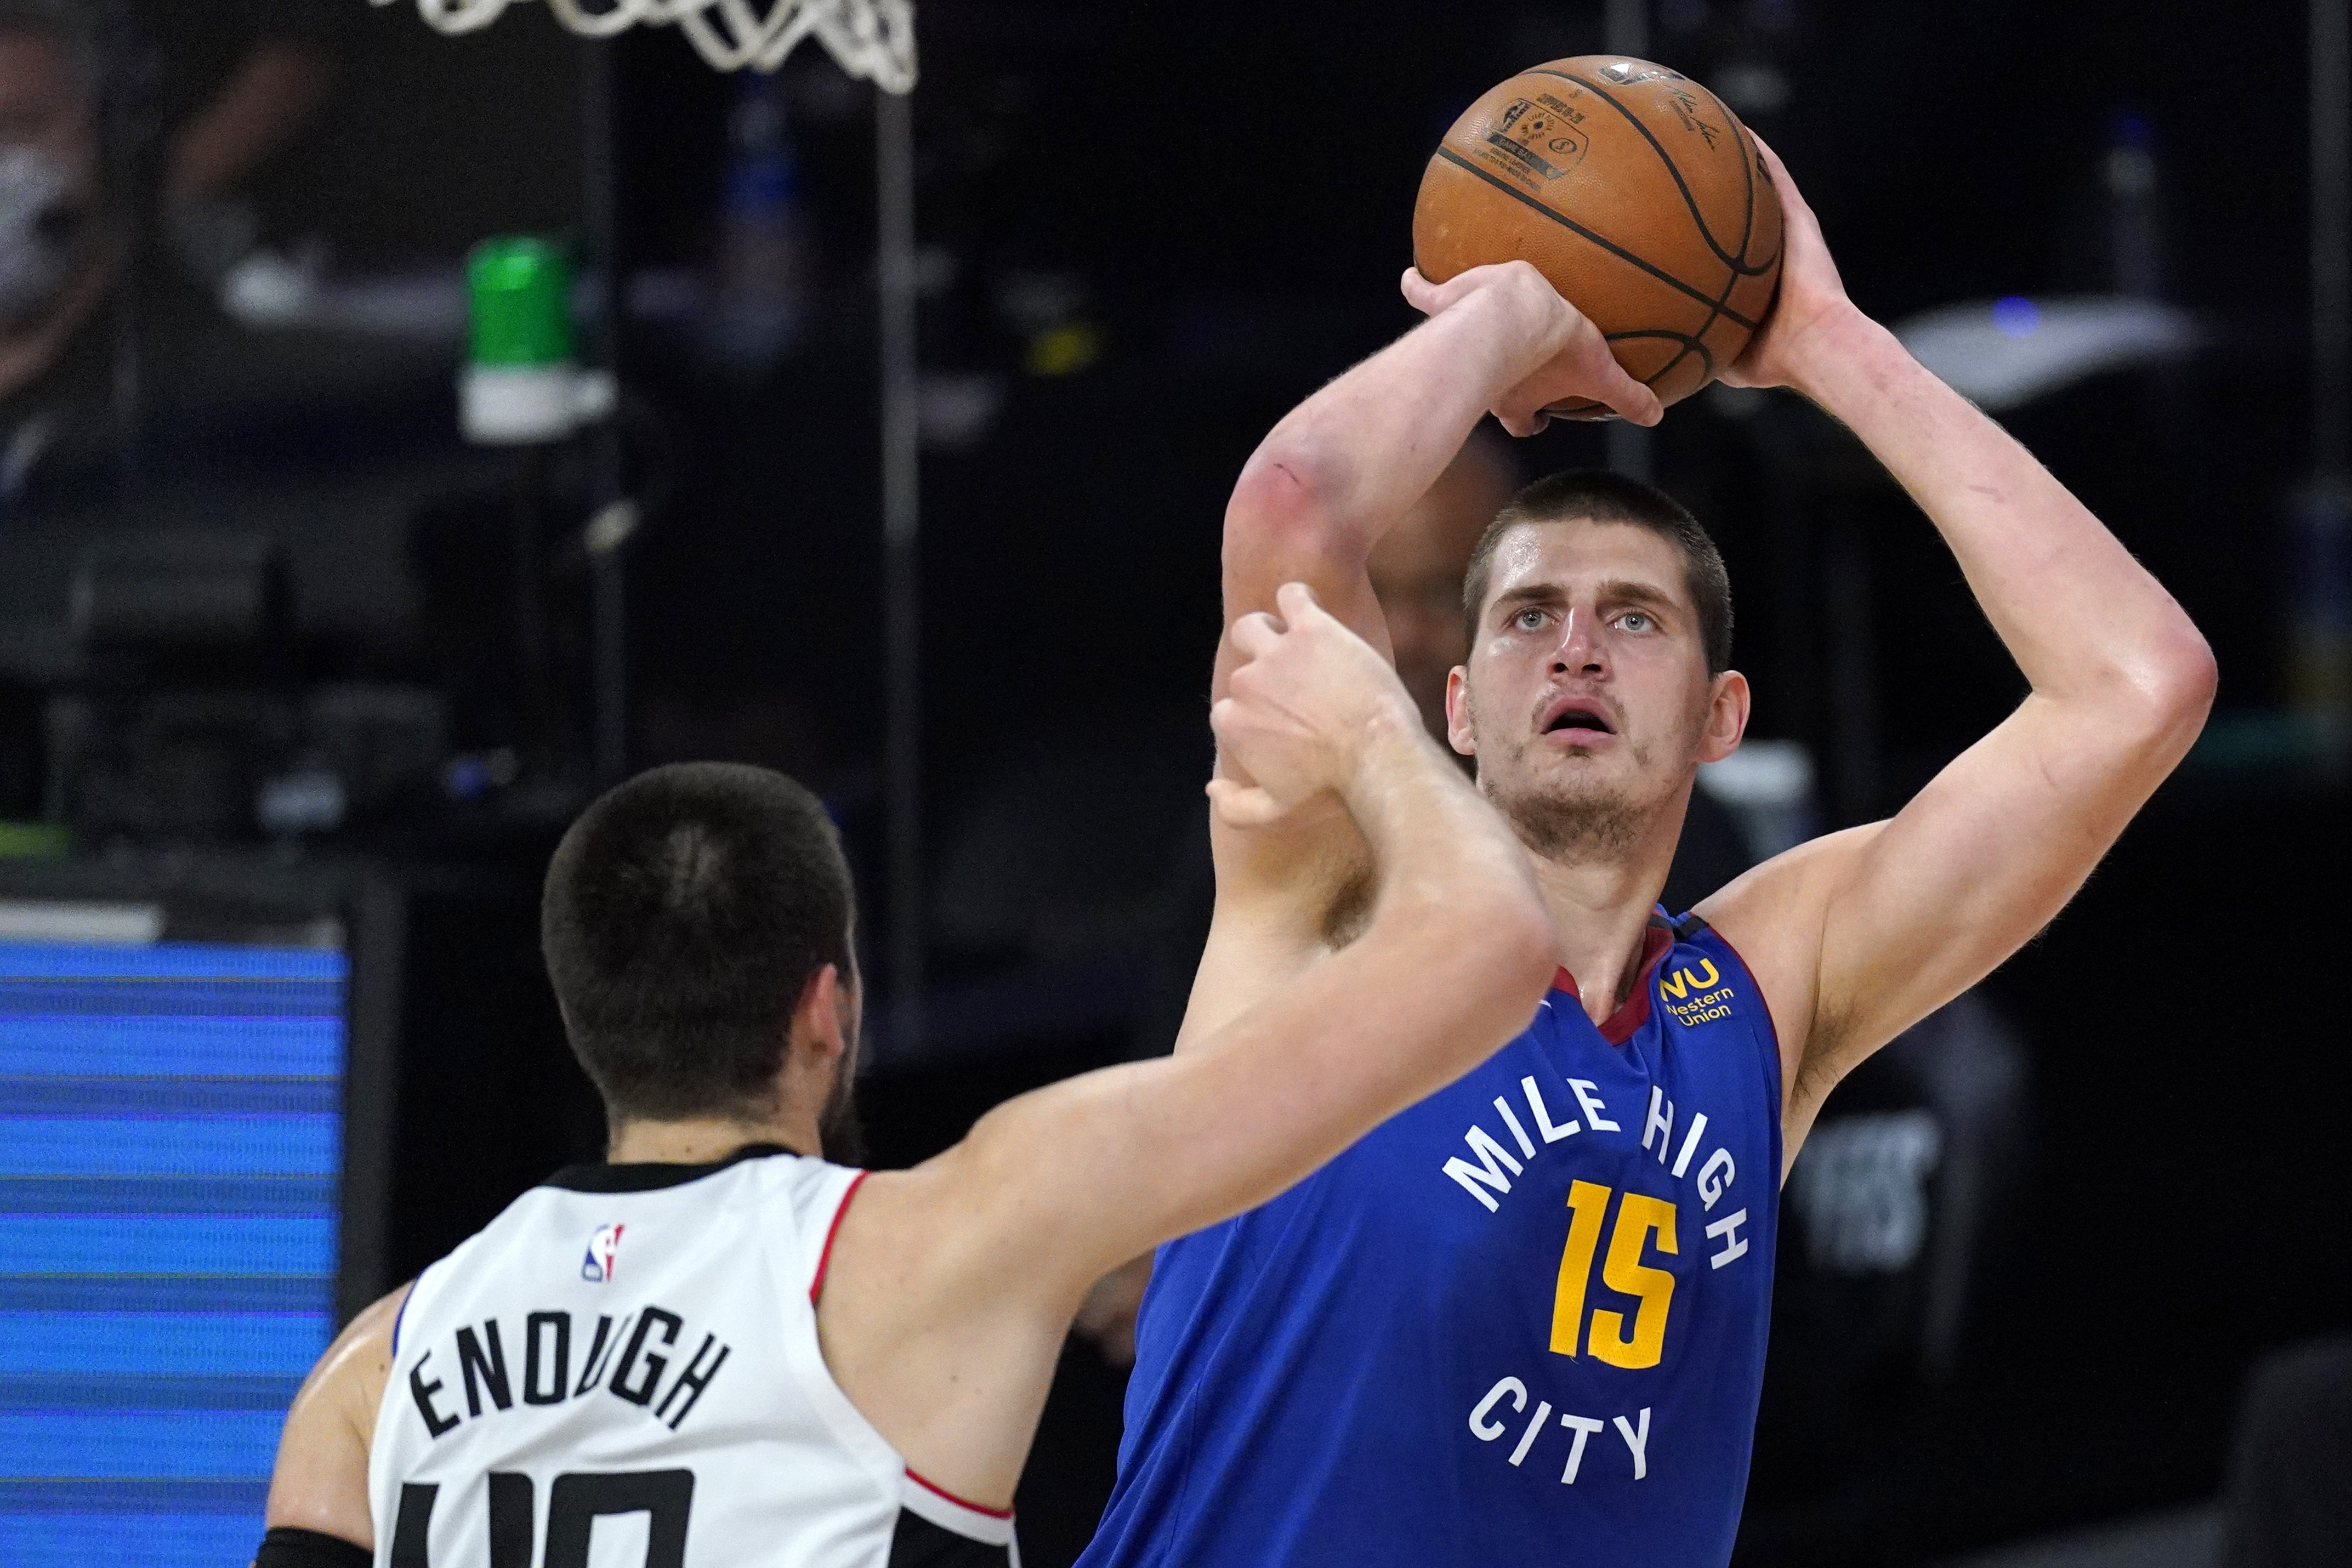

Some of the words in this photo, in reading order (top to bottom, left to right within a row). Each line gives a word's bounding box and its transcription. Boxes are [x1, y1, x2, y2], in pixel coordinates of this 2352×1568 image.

[1678, 1004, 1731, 1026] Union
[1442, 1075, 1621, 1213] MILE
[1642, 1084, 1748, 1270] HIGH
[1549, 1179, 1678, 1369] 15
[409, 1305, 731, 1439] ENOUGH
[1469, 1376, 1651, 1484] CITY
